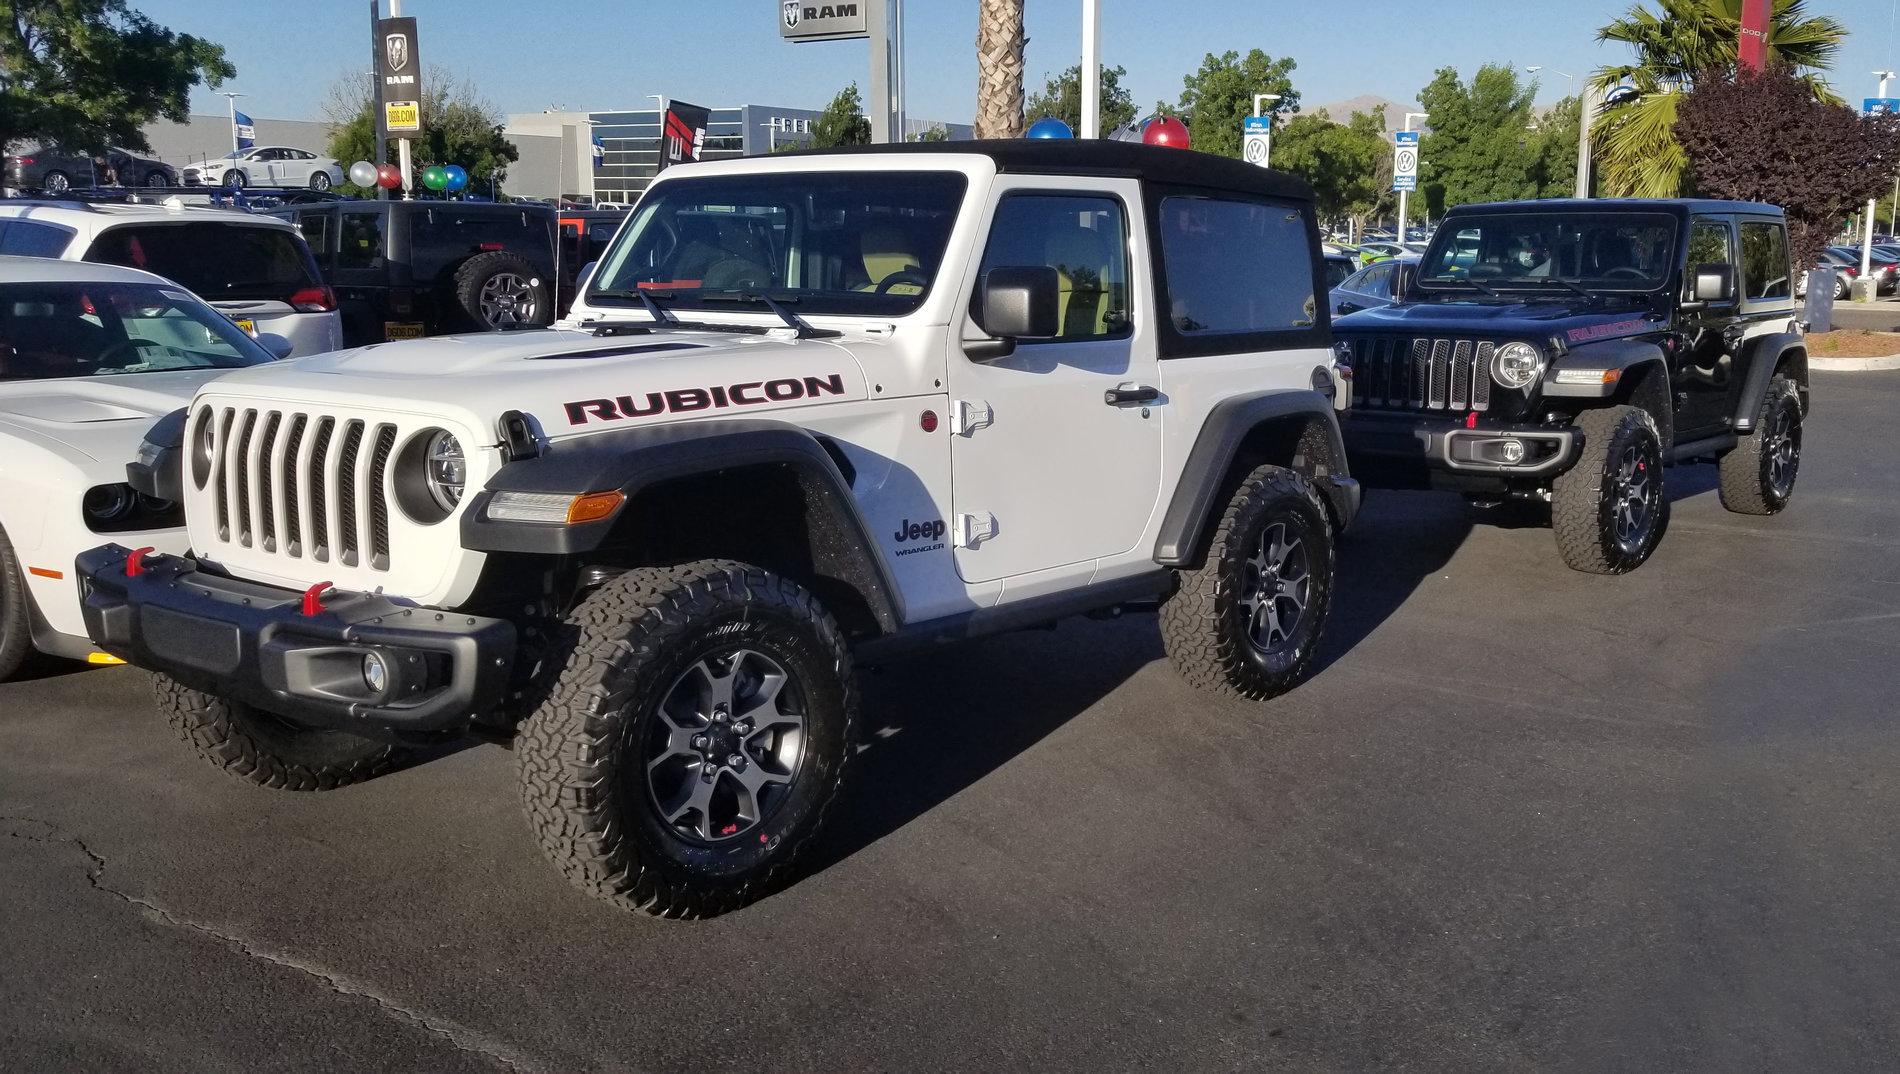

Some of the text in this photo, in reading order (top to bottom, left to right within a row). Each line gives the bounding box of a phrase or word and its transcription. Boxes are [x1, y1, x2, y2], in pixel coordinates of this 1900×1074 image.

[803, 4, 857, 20] RAM
[386, 75, 414, 85] RAM
[1567, 320, 1645, 341] RUBICON
[563, 373, 845, 426] RUBICON
[894, 519, 946, 542] Jeep
[895, 543, 945, 557] WRANGLER
